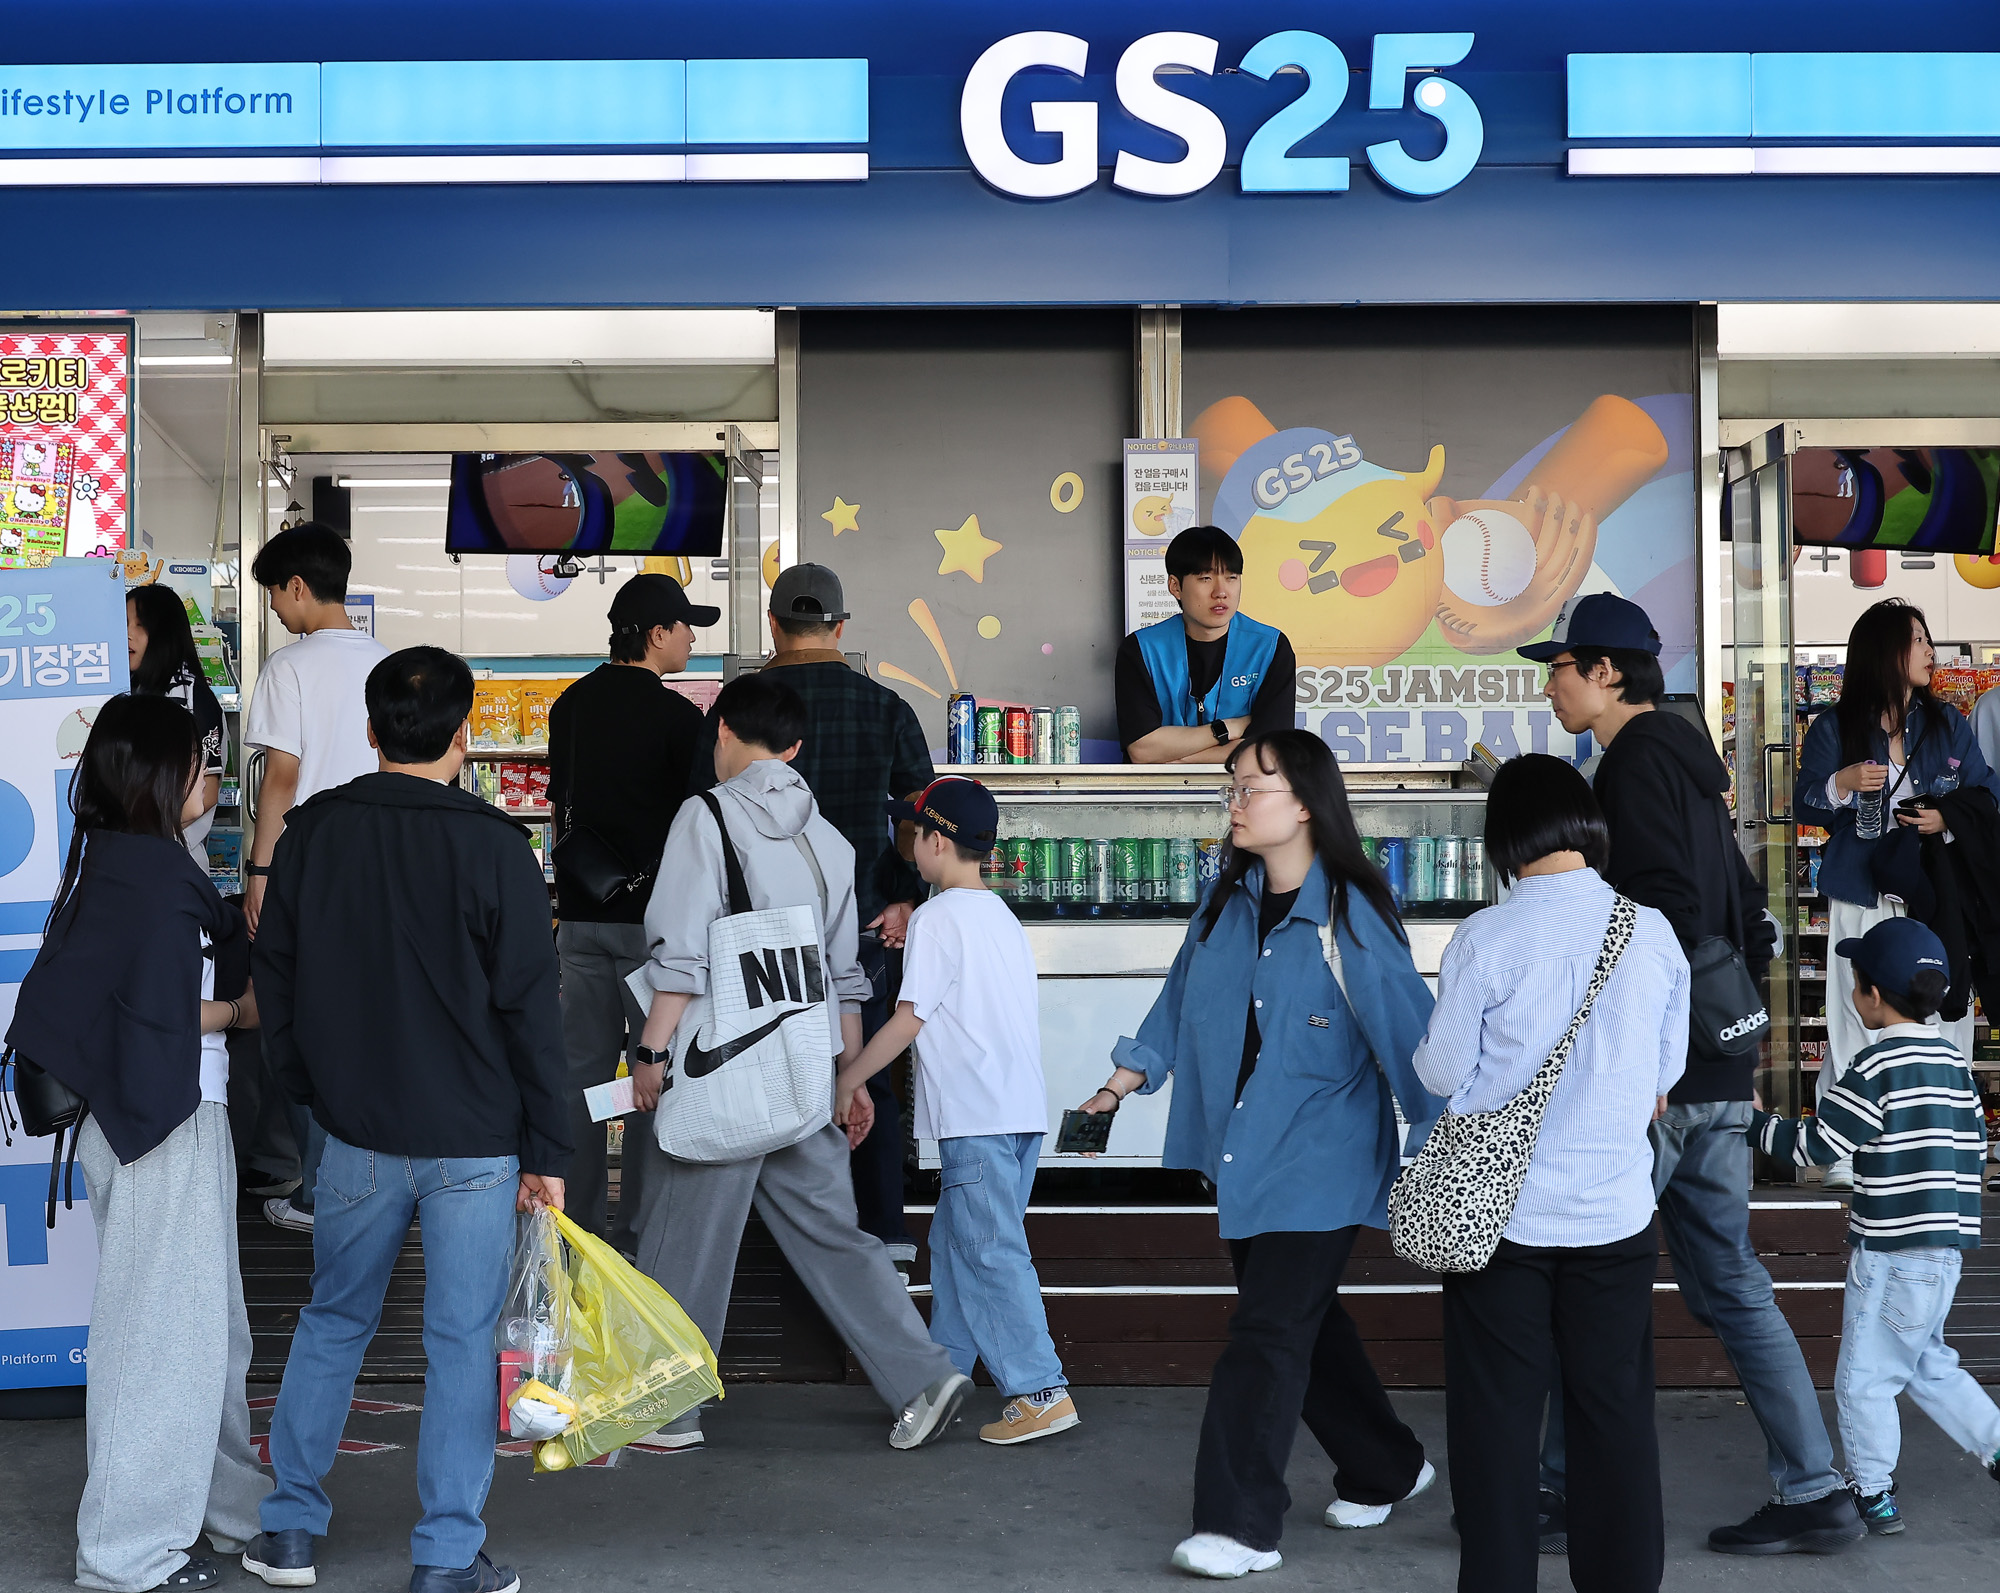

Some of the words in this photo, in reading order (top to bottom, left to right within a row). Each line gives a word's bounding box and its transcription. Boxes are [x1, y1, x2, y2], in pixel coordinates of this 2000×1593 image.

[1, 88, 130, 123] ifestyle
[146, 86, 293, 115] Platform
[959, 29, 1485, 197] GS25
[1127, 443, 1157, 451] NOTICE
[1168, 443, 1195, 451] 안내사항
[1134, 468, 1143, 478] 잔
[1144, 468, 1160, 478] 얼음
[1162, 468, 1179, 478] 구매
[1180, 468, 1188, 478] 시
[1255, 435, 1362, 508] GS25
[1135, 482, 1151, 491] 컵을
[1152, 482, 1188, 491] 드립니다!
[1139, 574, 1166, 585] 신분증
[1720, 1010, 1769, 1041] adidas
[2, 1353, 57, 1365] Platform
